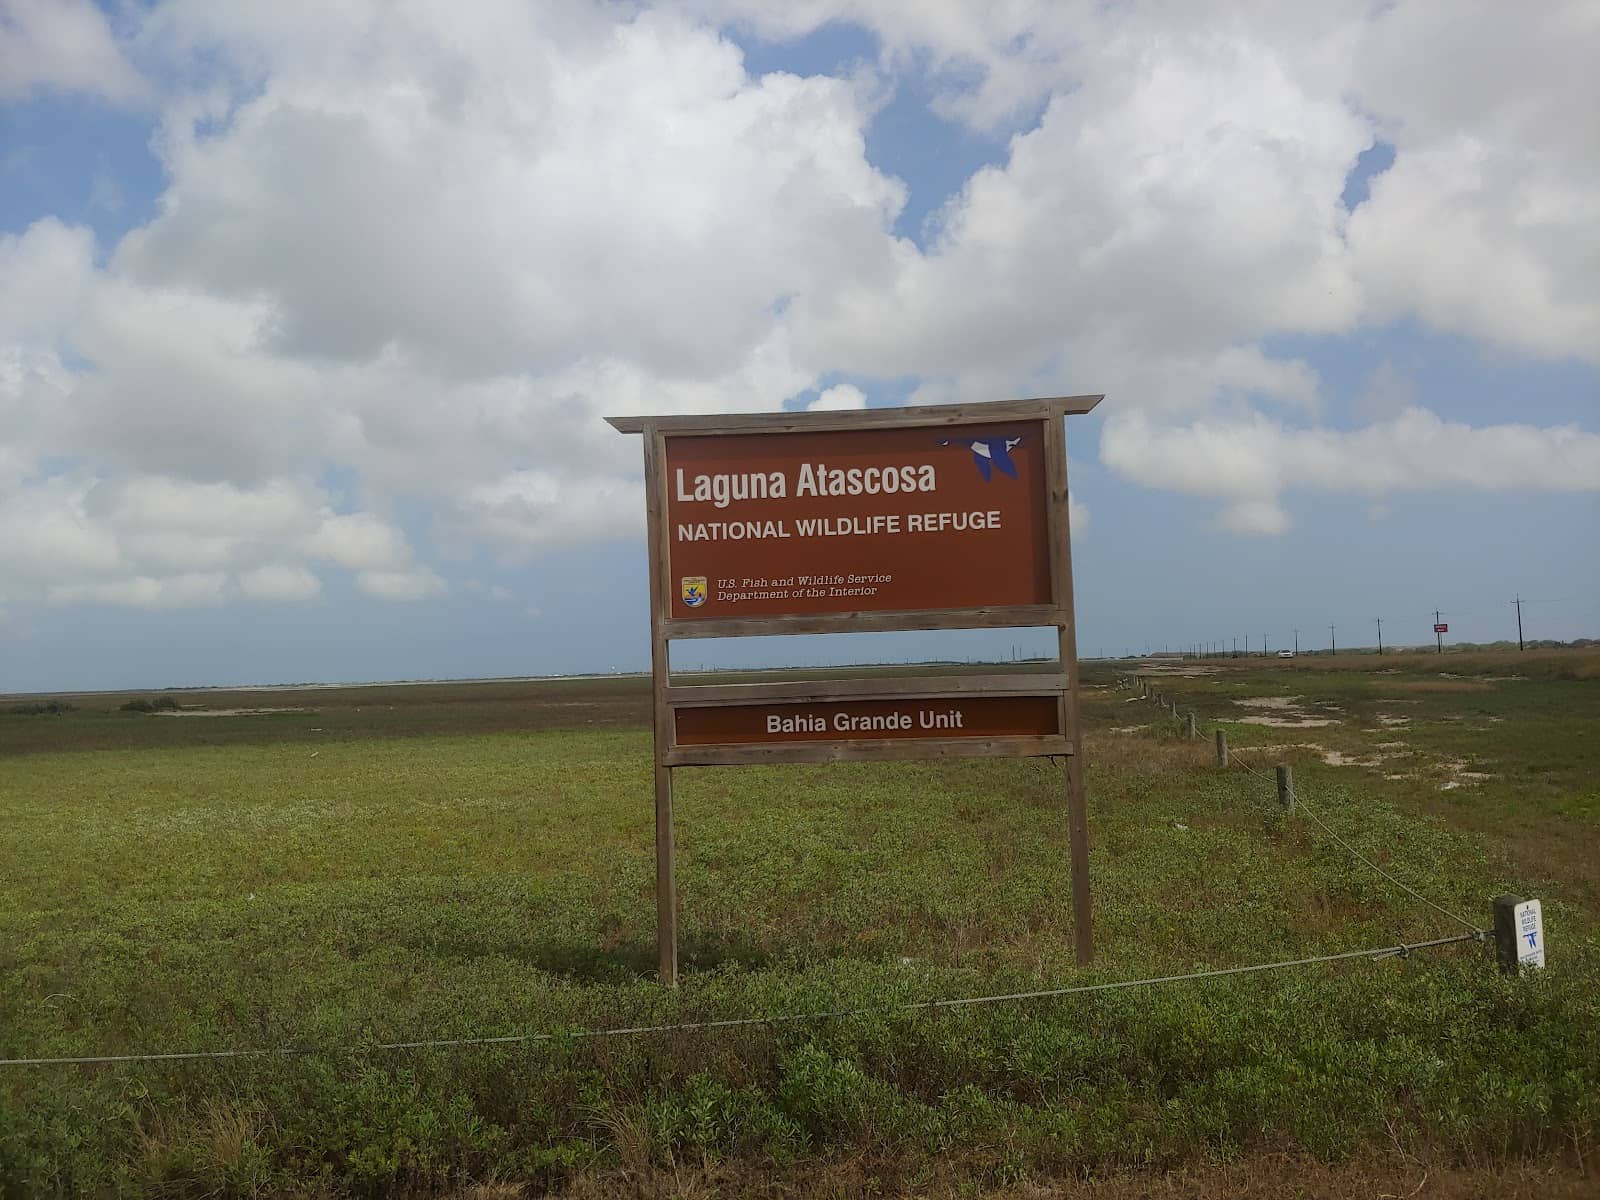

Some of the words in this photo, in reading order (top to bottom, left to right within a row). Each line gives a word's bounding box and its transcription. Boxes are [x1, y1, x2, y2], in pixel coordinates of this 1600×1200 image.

[676, 468, 787, 509] Laguna
[796, 463, 936, 497] Atascosa
[678, 520, 791, 542] NATIONAL
[795, 515, 901, 537] WILDLIFE
[907, 510, 1002, 533] REFUGE
[717, 579, 738, 589] U.S.
[742, 577, 768, 588] Fish
[771, 576, 794, 587] and
[798, 575, 844, 586] Wildlife
[847, 574, 892, 584] Service
[717, 589, 789, 602] Department
[792, 588, 806, 598] of
[806, 587, 826, 598] the
[829, 586, 878, 597] Interior
[766, 714, 826, 733] Bahia
[833, 711, 913, 731] Grande
[919, 710, 963, 729] Unit
